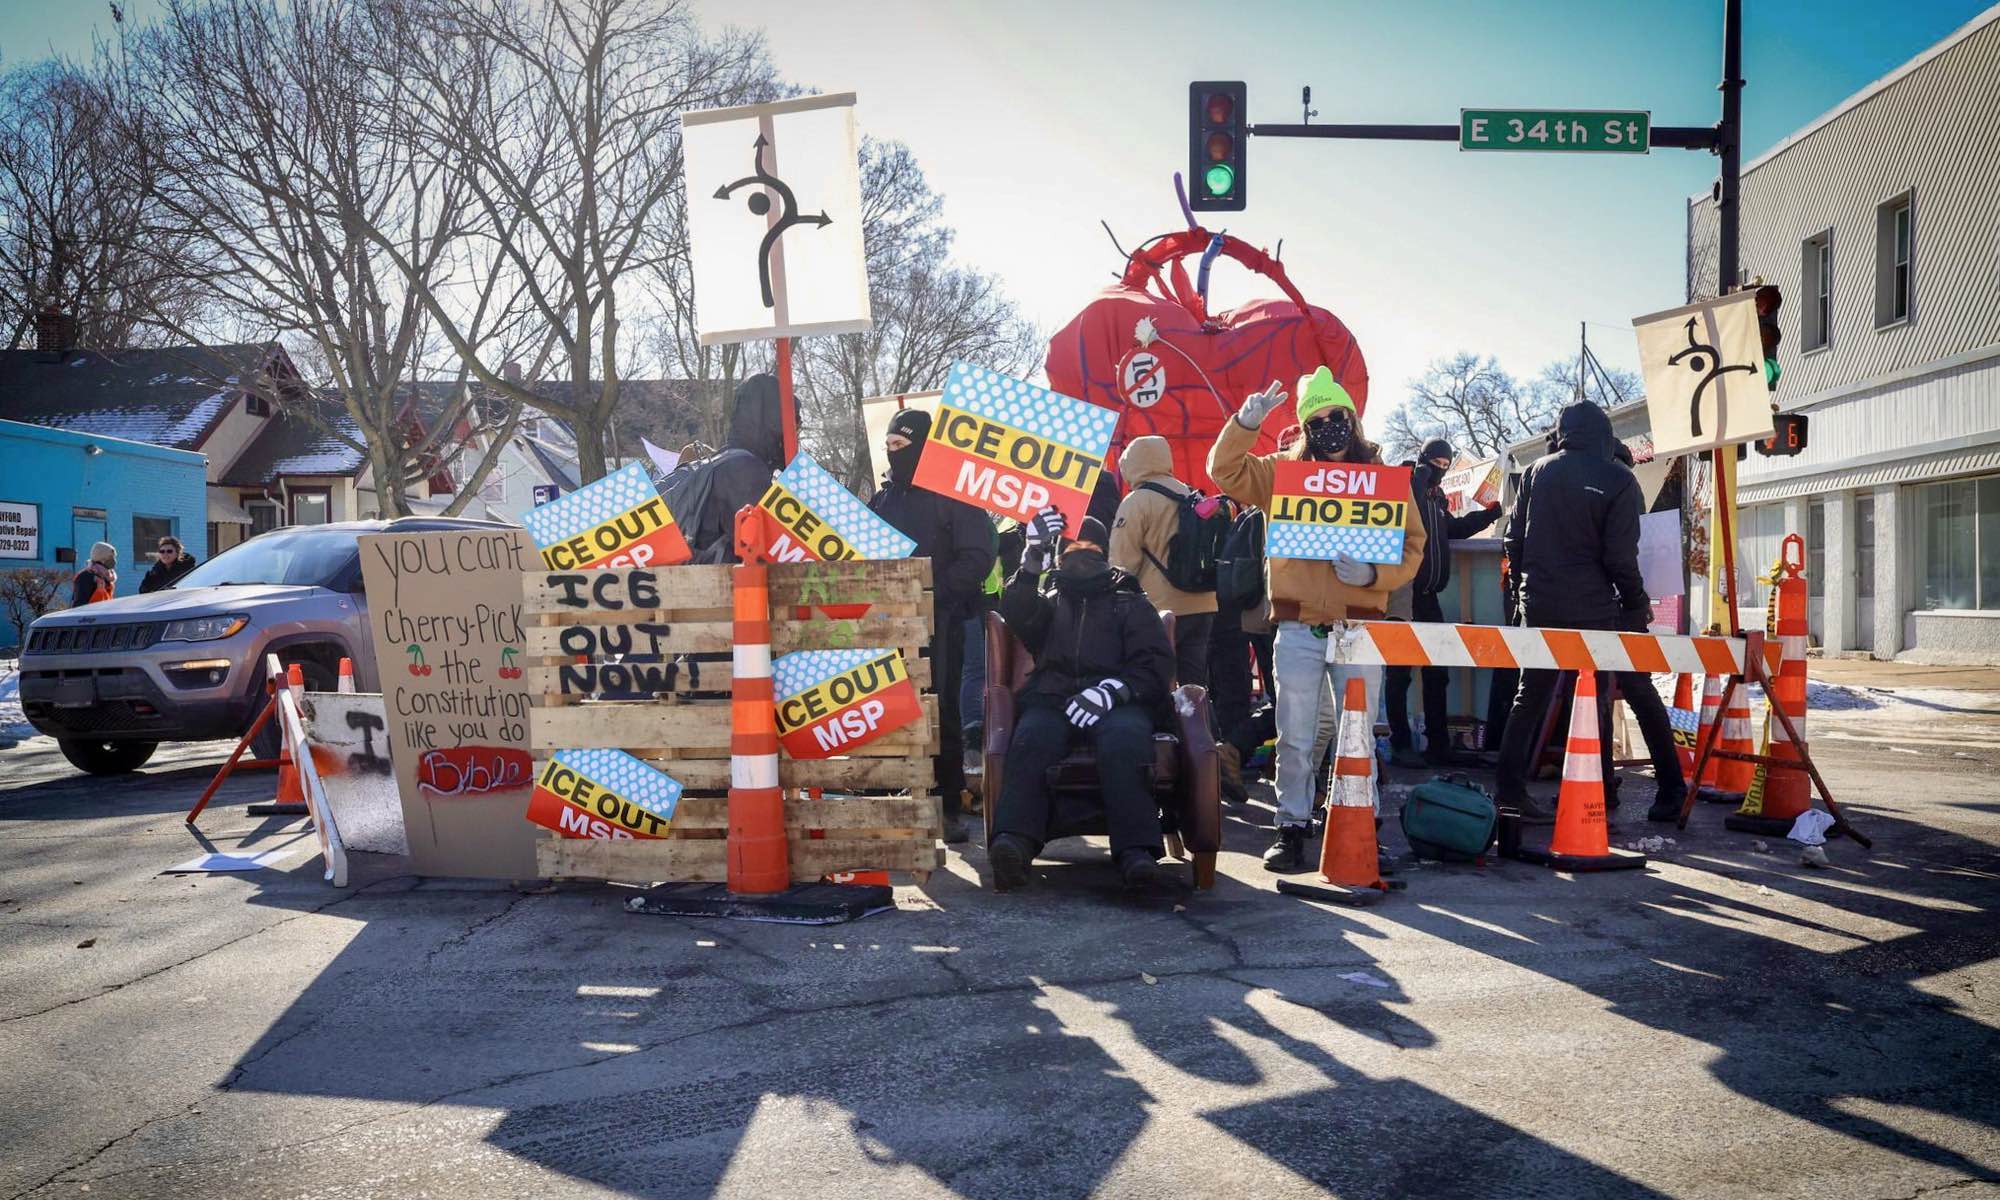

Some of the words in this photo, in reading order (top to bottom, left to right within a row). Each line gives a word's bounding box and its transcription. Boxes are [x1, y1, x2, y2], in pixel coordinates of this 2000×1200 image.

[1471, 118, 1489, 142] E
[1505, 118, 1589, 144] 34th
[1603, 119, 1639, 145] St
[1132, 356, 1159, 404] ICE
[933, 408, 1005, 459] ICE
[1010, 436, 1102, 489] OUT
[954, 459, 1050, 515] MSP
[1303, 468, 1377, 496] MSP
[763, 486, 822, 542] ICE
[1273, 497, 1343, 524] OUT
[1350, 501, 1404, 527] ICE
[16, 525, 37, 537] Repair
[542, 536, 595, 571] ICE
[594, 499, 664, 552] OUT
[456, 532, 526, 572] can't
[546, 571, 661, 610] ICE
[559, 623, 671, 656] OUT
[440, 649, 484, 685] the
[559, 661, 700, 694] NOW!
[395, 685, 534, 719] Constitution
[774, 688, 828, 735] ICE
[829, 653, 897, 705] OUT
[404, 719, 438, 751] like
[448, 722, 488, 748] you
[500, 717, 525, 743] do
[812, 699, 885, 752] MSP
[541, 761, 595, 808] ICE
[597, 792, 667, 836] OUT
